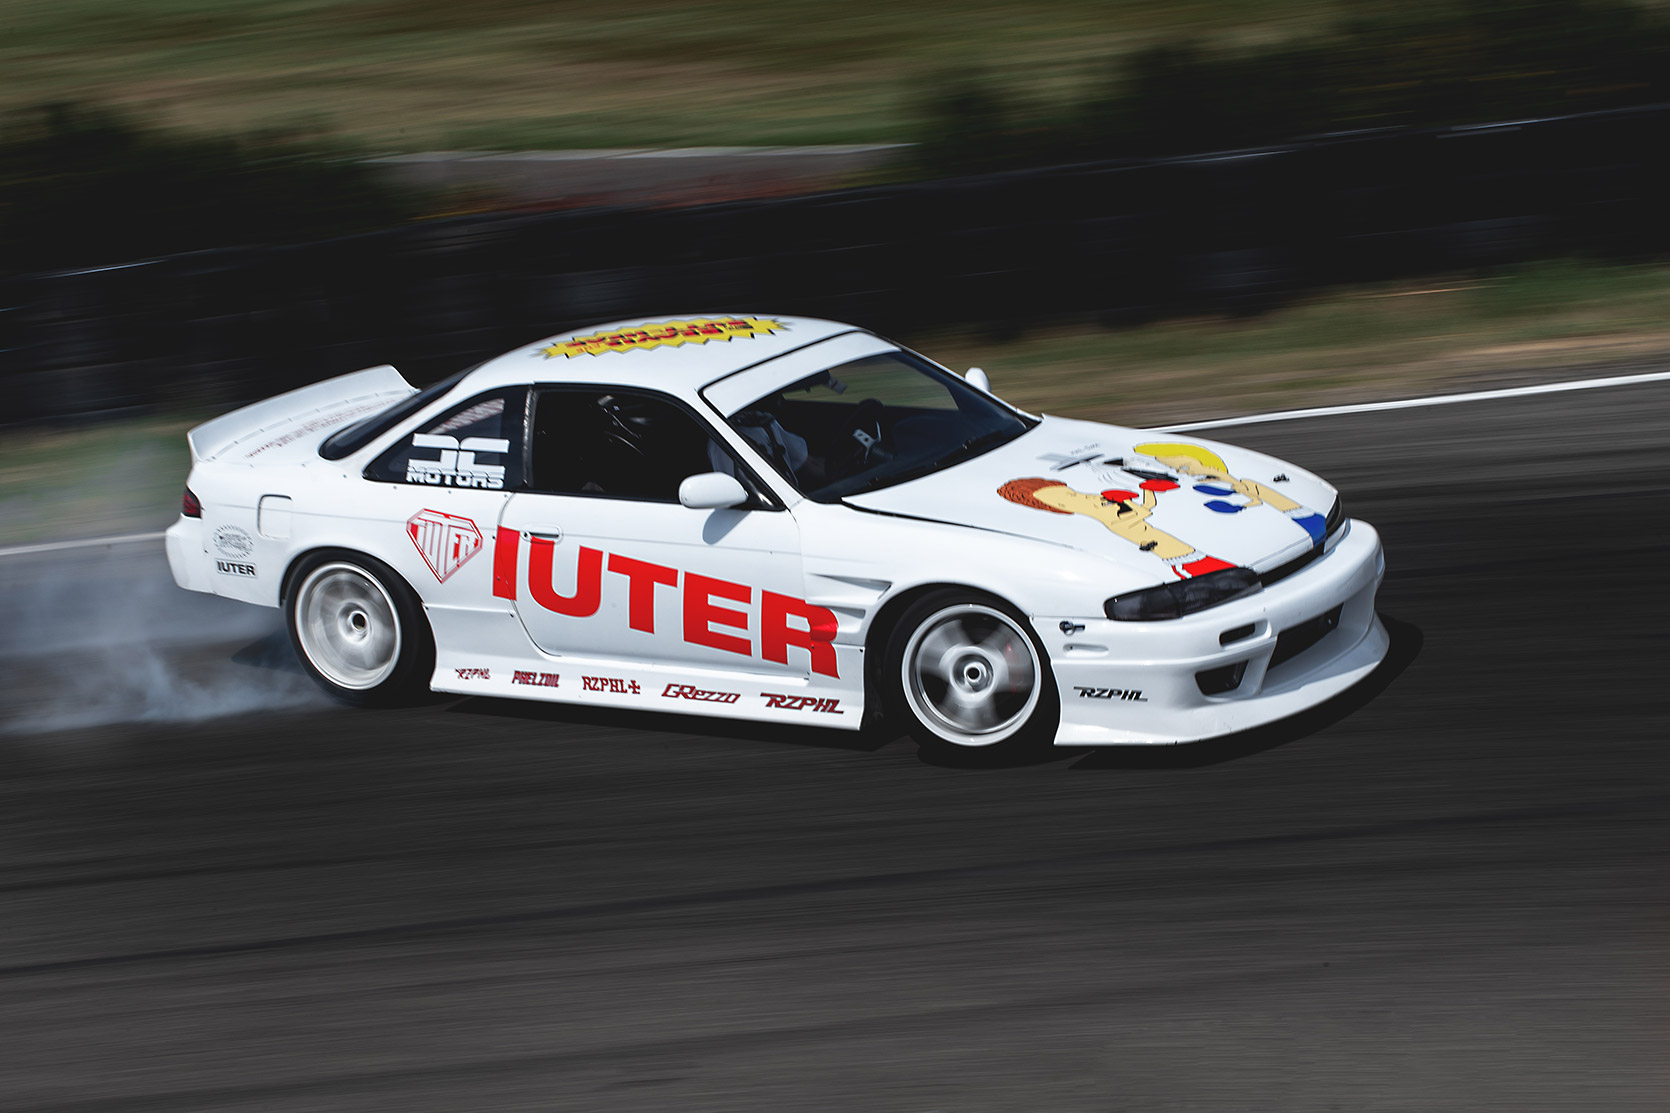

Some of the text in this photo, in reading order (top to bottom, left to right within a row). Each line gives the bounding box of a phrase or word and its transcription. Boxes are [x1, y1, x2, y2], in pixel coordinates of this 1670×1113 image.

[406, 464, 505, 490] MOTORS
[216, 560, 256, 576] IUTER
[492, 525, 840, 680] IUTER
[760, 692, 845, 714] RZPHL
[1073, 686, 1149, 702] RZPHL
